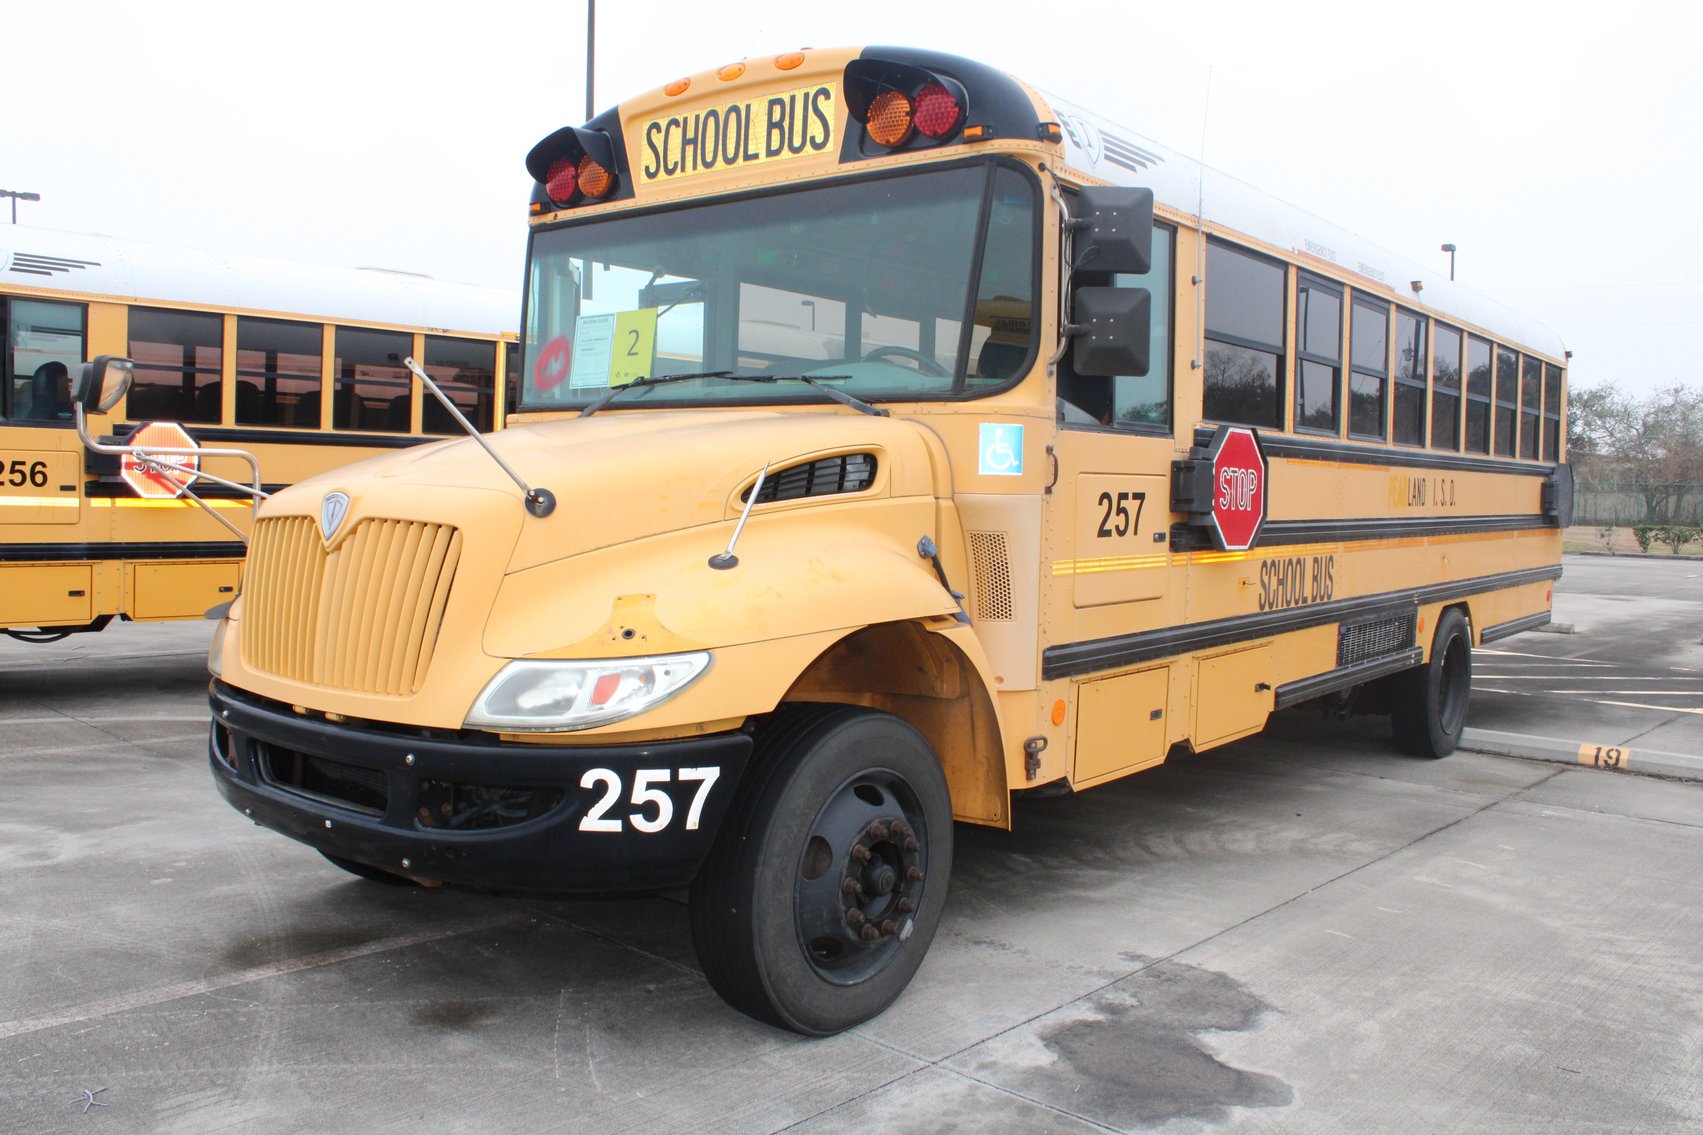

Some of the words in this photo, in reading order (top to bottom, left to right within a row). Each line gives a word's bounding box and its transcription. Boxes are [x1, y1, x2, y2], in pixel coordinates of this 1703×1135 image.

[644, 103, 760, 180] SCHOOL
[765, 86, 831, 158] BUS
[627, 329, 640, 357] 2
[0, 460, 48, 488] 56
[1219, 466, 1257, 511] STOP
[1096, 491, 1146, 538] 257
[1258, 557, 1308, 612] SCHOOL
[1311, 554, 1334, 604] BUS
[1594, 746, 1621, 768] 19
[578, 766, 721, 833] 257
